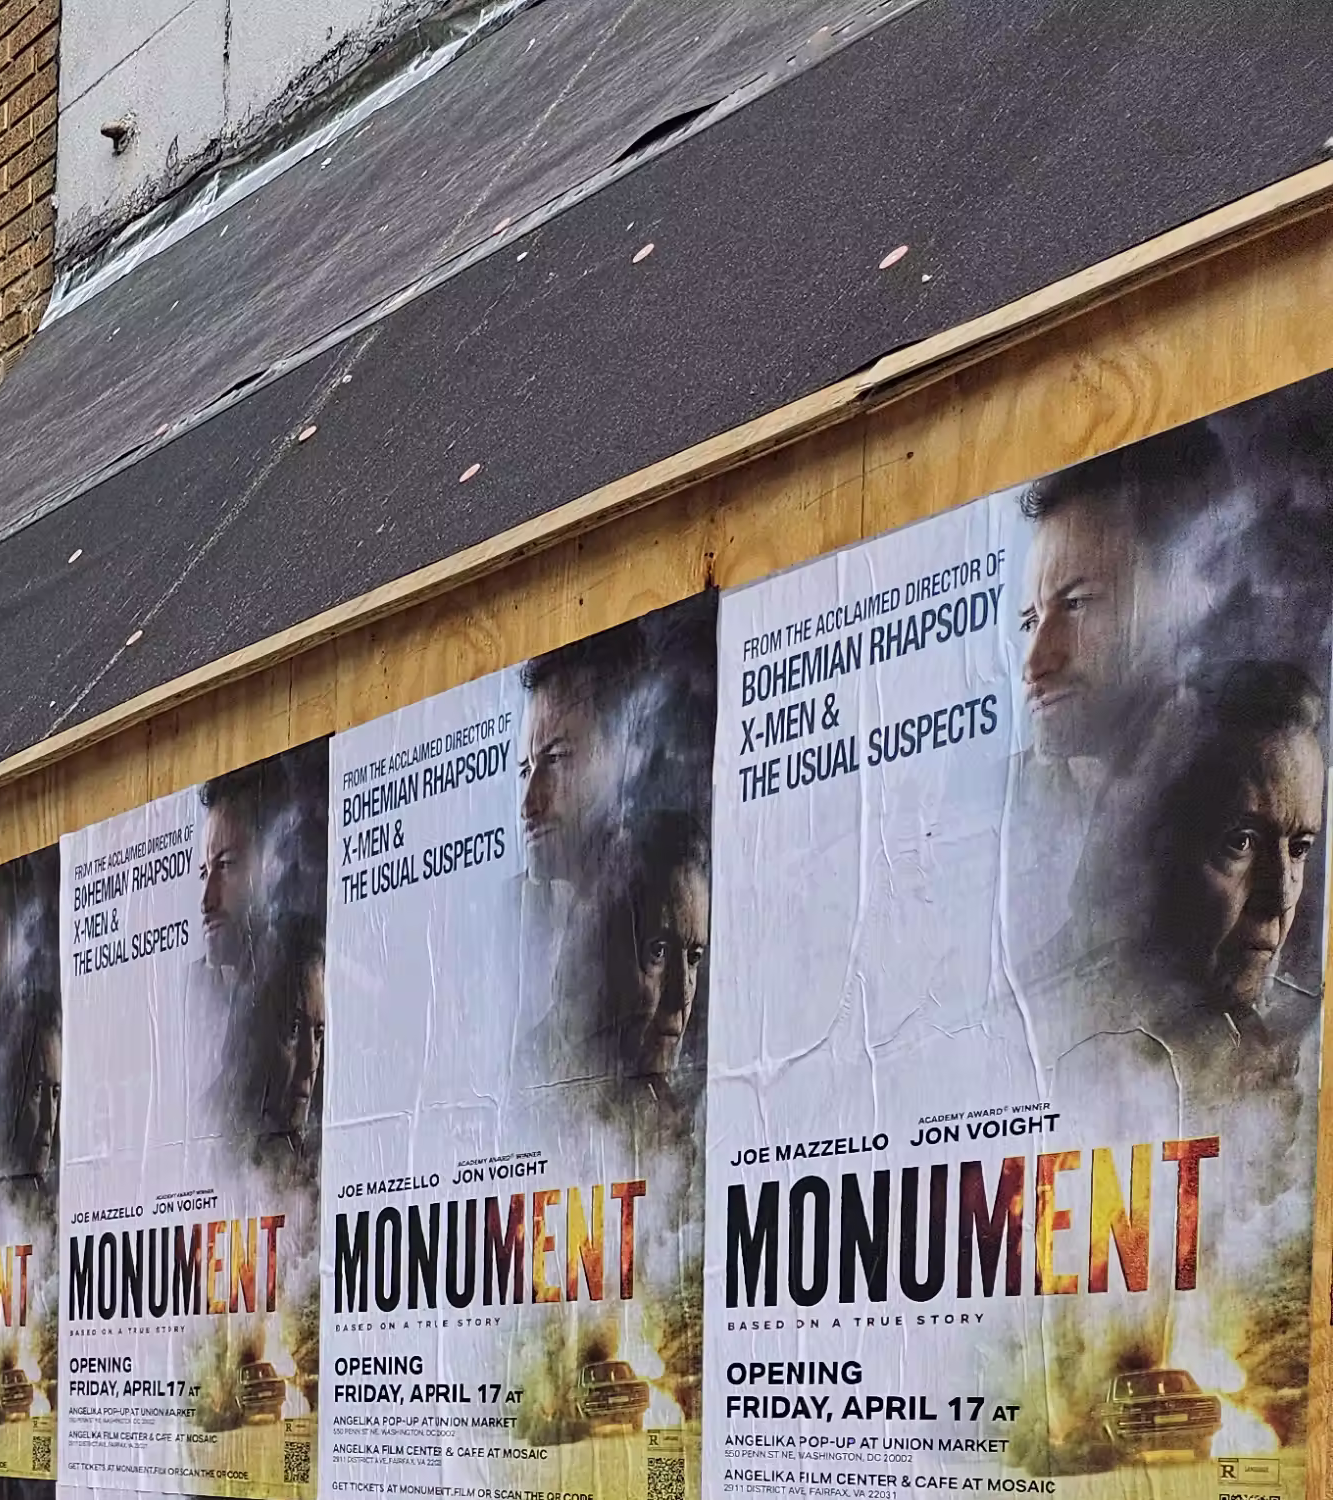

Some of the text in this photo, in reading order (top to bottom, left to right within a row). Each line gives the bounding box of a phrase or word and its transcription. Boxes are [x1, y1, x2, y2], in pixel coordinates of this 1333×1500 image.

[744, 549, 1006, 662] FROM THE ACCLAIMED DIRECTOR OF
[742, 583, 1006, 707] BOHEMIAN RHAPSODY
[740, 692, 840, 756] X-MEN &
[739, 694, 998, 802] THE USUAL SUSPECTS
[343, 739, 511, 827] BOHEMIAN RHAPSODY
[342, 819, 405, 867] X-MEN &
[342, 827, 505, 904] THE USUAL SUSPECTS
[918, 1112, 965, 1125] ACADEMY
[1011, 1102, 1051, 1114] WINNER
[731, 1113, 1061, 1167] JOE MAZZELLO JON VOIGHT
[725, 1136, 1220, 1308] MONUMENT
[334, 1180, 646, 1314] MONUMENT
[69, 1214, 285, 1321] MONUMENT
[727, 1319, 786, 1332] BASED
[832, 1318, 843, 1329] A
[854, 1315, 903, 1328] TRUE
[917, 1313, 985, 1326] STORY
[69, 1357, 132, 1374] OPENING
[334, 1355, 423, 1376] OPENING
[726, 1360, 863, 1387] OPENING
[726, 1395, 1020, 1423] FRIDAY, APRIL 17 AT
[725, 1434, 1009, 1453] ANGELIKA POP-UP AT UNION MARKET
[742, 1450, 766, 1459] PENN
[767, 1450, 780, 1459] ST
[867, 1453, 881, 1462] DC
[724, 1469, 1056, 1494] ANGELIKA FILM CENTER & CAFE AT MOSAIC
[1220, 1464, 1236, 1479] R
[746, 1485, 786, 1494] DISTRICT
[853, 1489, 866, 1498] VA
